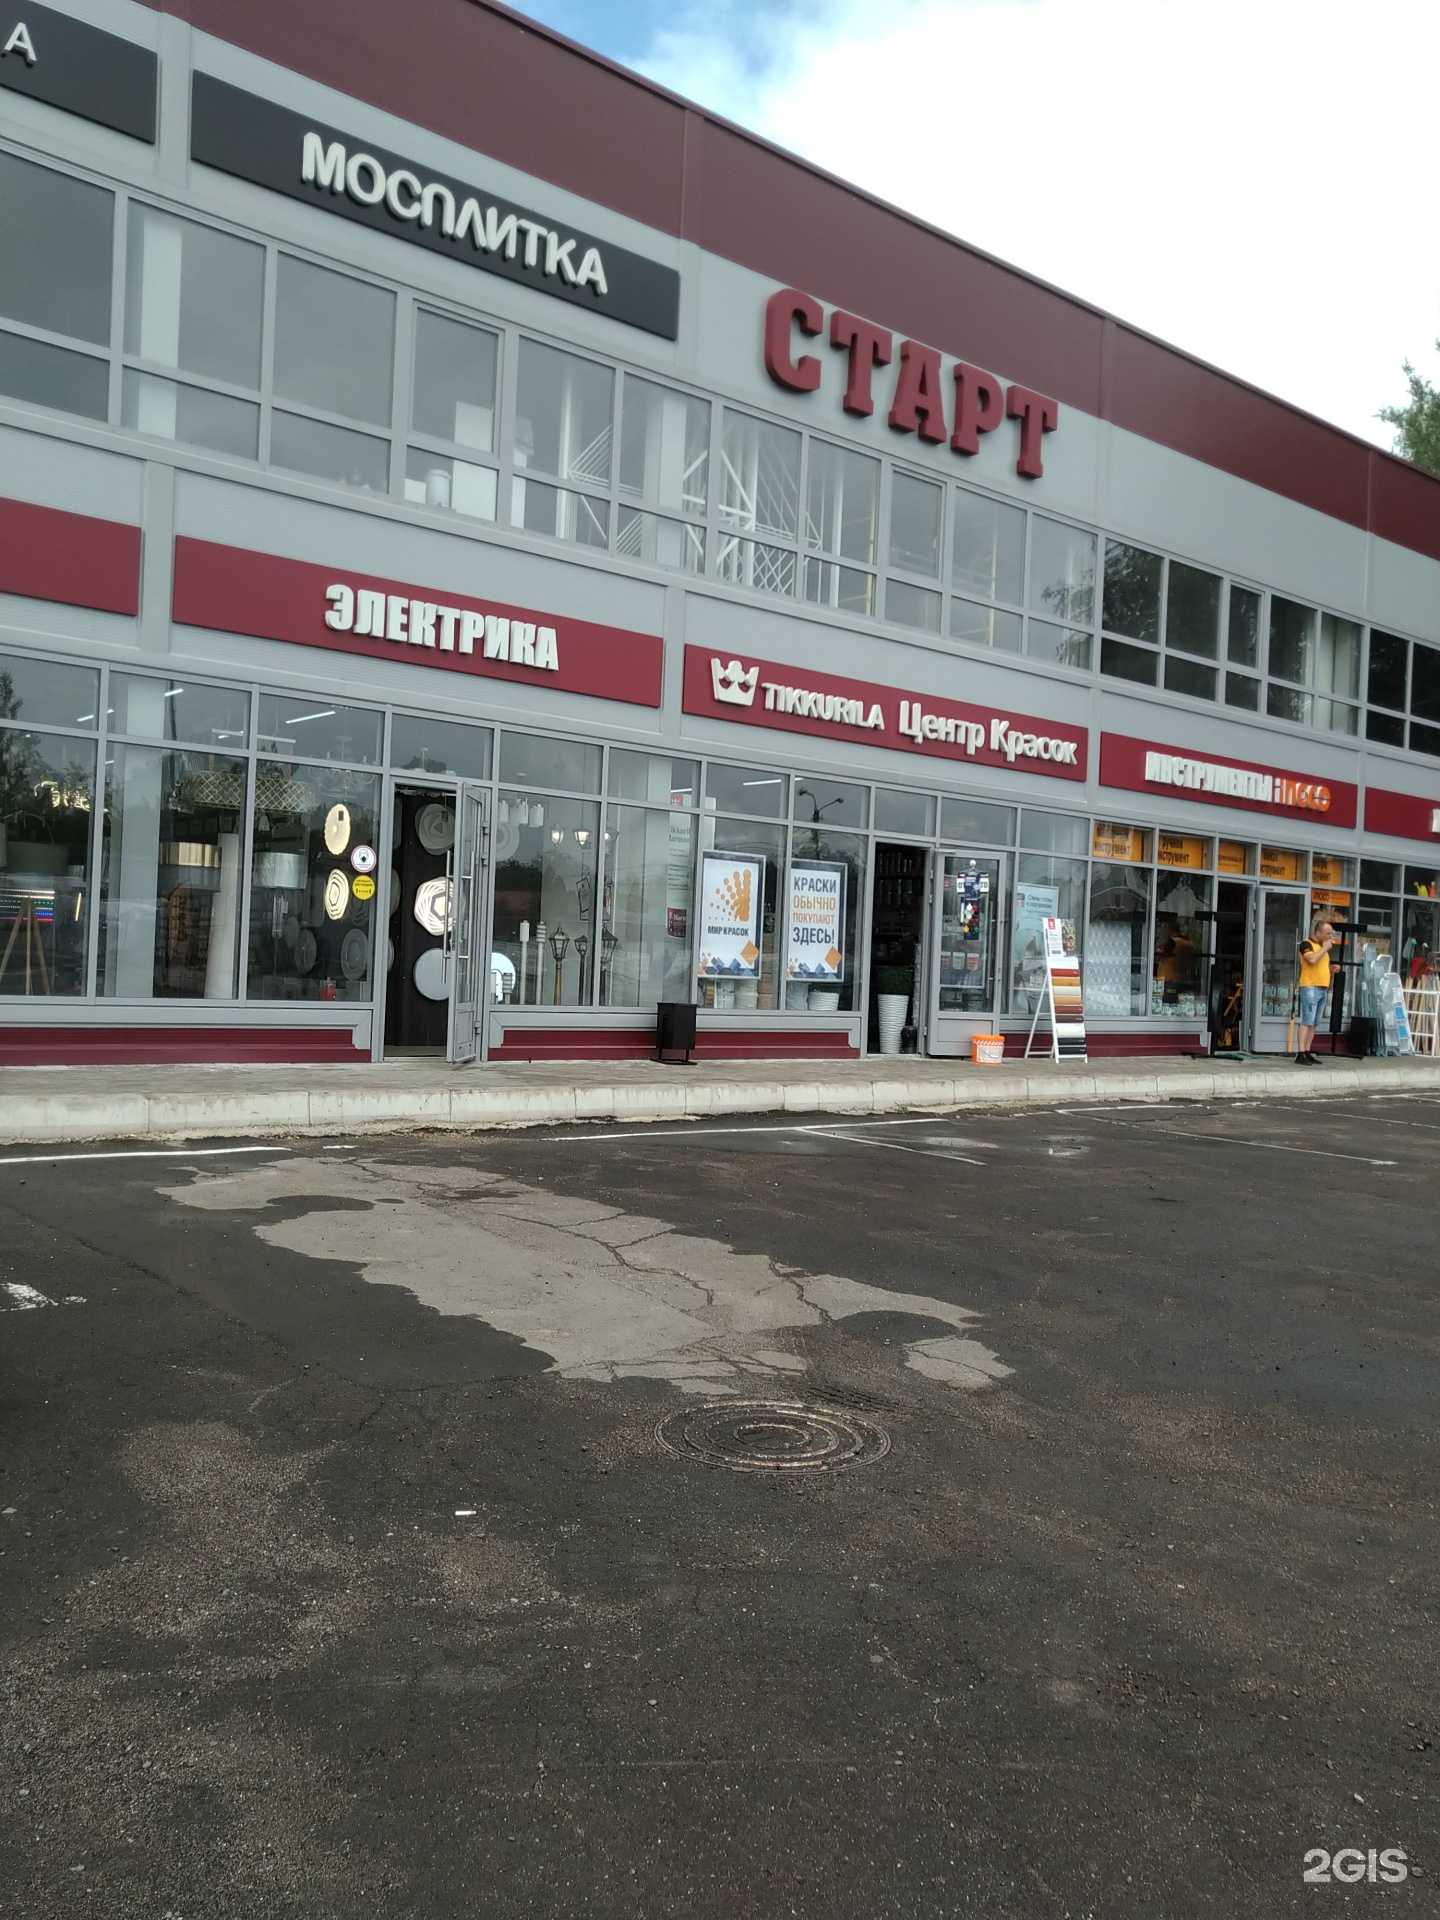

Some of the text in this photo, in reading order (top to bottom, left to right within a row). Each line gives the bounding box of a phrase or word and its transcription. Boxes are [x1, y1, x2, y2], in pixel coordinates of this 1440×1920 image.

[301, 131, 609, 296] МОСПЛИТКА
[764, 288, 1058, 479] СТАРТ
[324, 583, 560, 672] ЭЛЕКТРИКА
[761, 682, 886, 731] TIKKURILA
[899, 700, 1079, 765] Центр Красок
[1144, 751, 1272, 804] ИНСТРУМЕНТЫ
[793, 895, 836, 911] ОБЫЧНО
[794, 876, 837, 893] КРАСКИ
[707, 926, 750, 937] МИР КРАСОК
[792, 911, 835, 925] ПОКУПАЮТ
[792, 926, 835, 946] ЗДЕСЬ!
